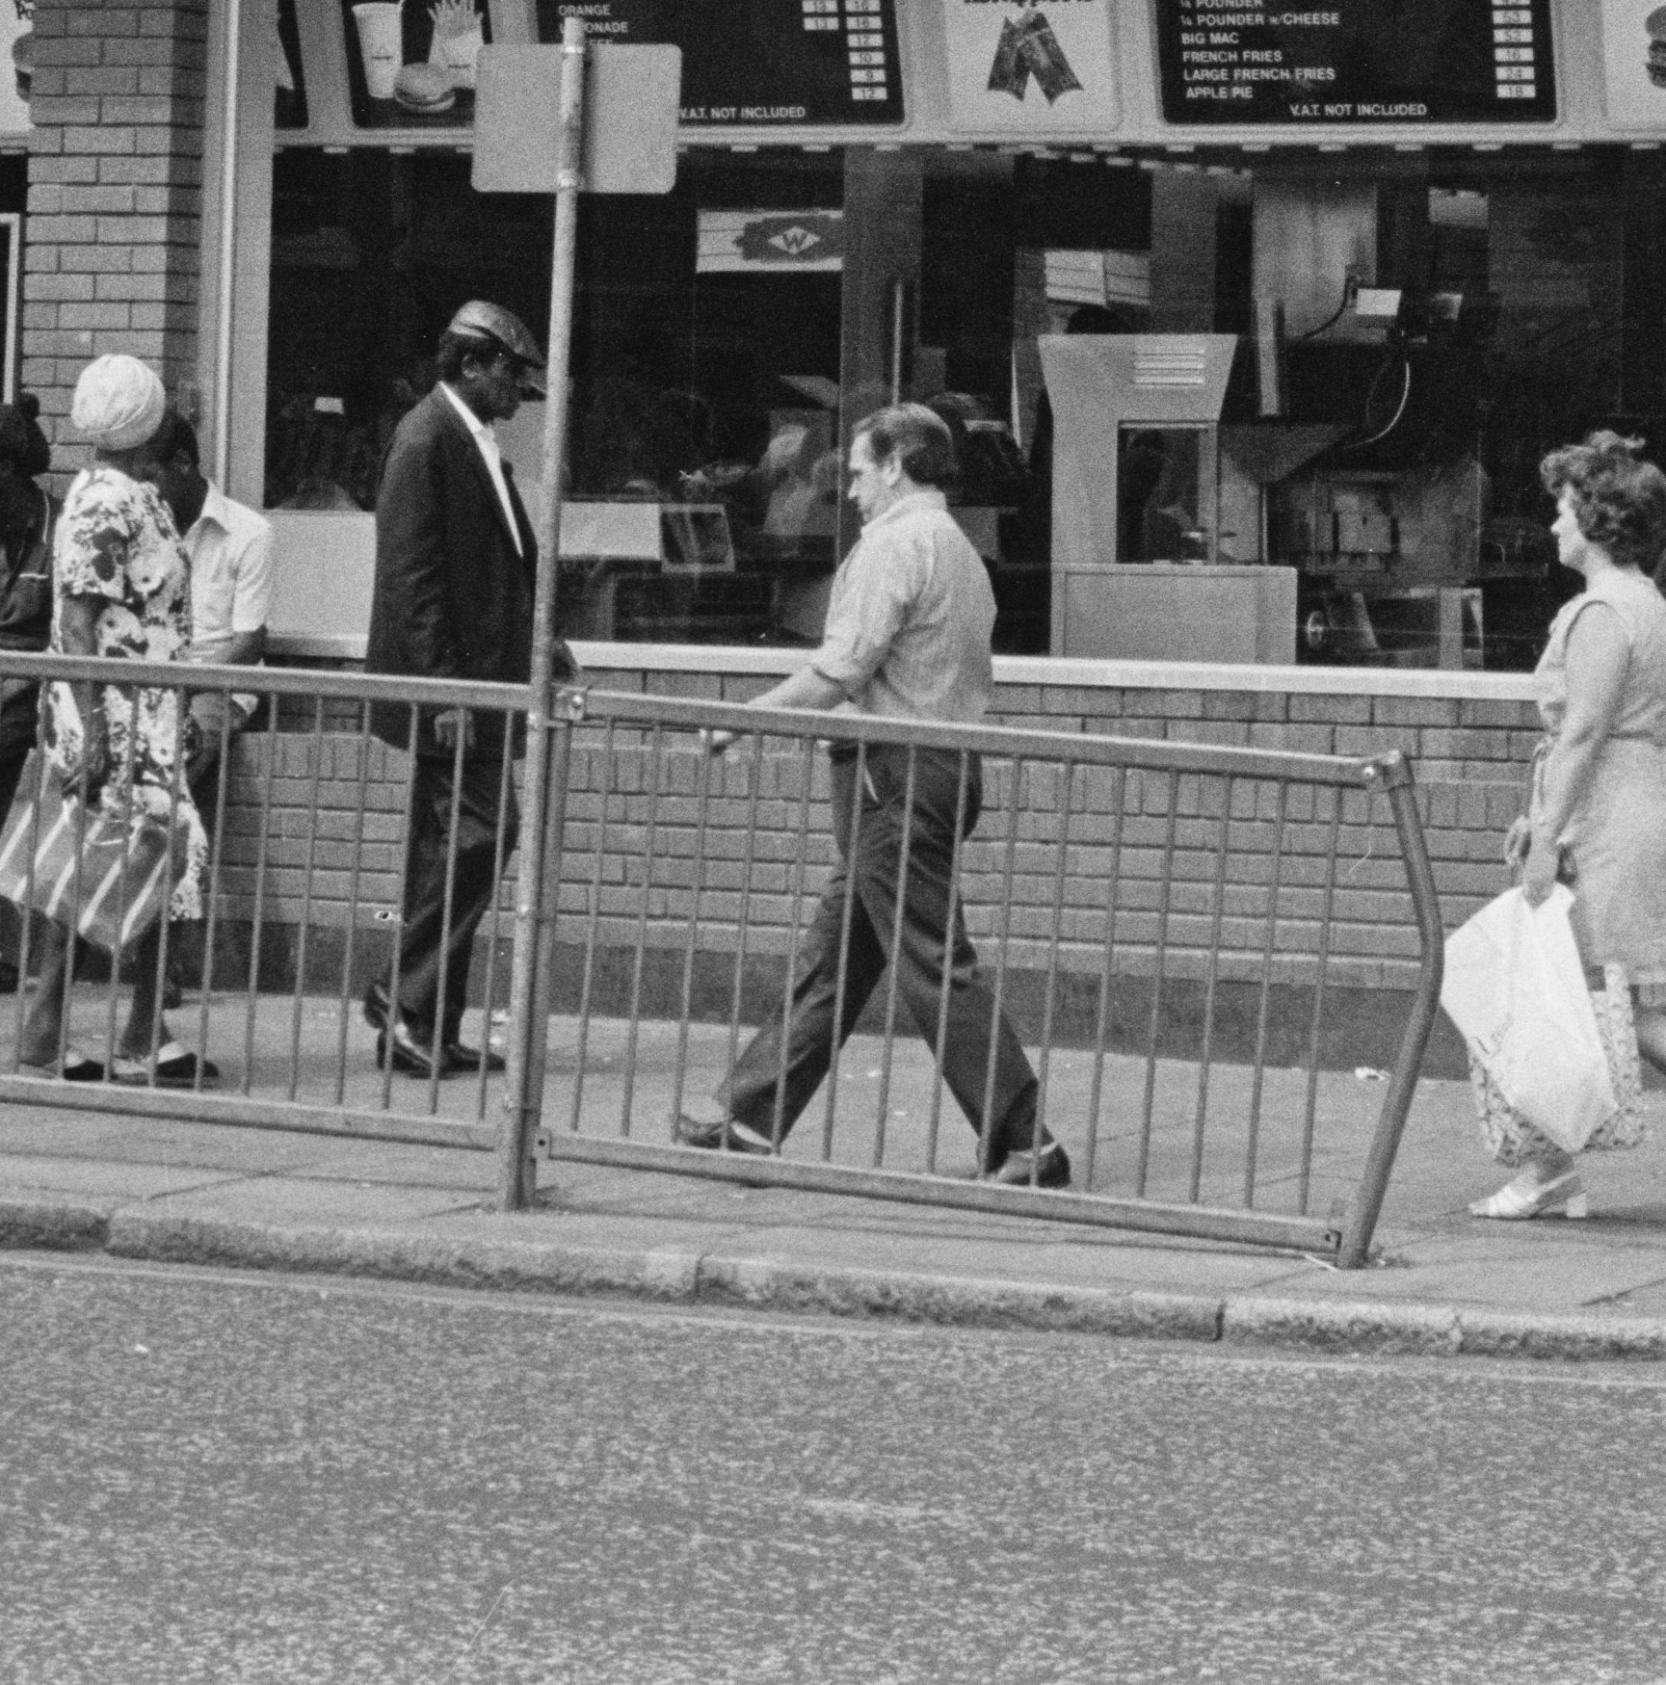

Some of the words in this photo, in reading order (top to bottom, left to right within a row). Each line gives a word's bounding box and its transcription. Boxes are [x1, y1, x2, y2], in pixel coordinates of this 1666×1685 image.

[558, 3, 611, 17] ORANGE
[1197, 14, 1264, 26] POUNDER
[1181, 33, 1205, 45] BIG
[1210, 32, 1239, 44] MAC
[1183, 50, 1237, 63] FRENCH
[1243, 50, 1282, 62] FRIES
[1183, 68, 1229, 81] LARGE
[1234, 68, 1290, 81] FRENCH
[1295, 67, 1335, 80] FRIES
[1186, 86, 1228, 99] APPLE
[1232, 86, 1253, 99] PIE
[711, 107, 736, 118] NOT
[741, 106, 805, 118] INCLUDED
[1325, 103, 1352, 116] NOT
[1357, 102, 1427, 116] INCLUDED
